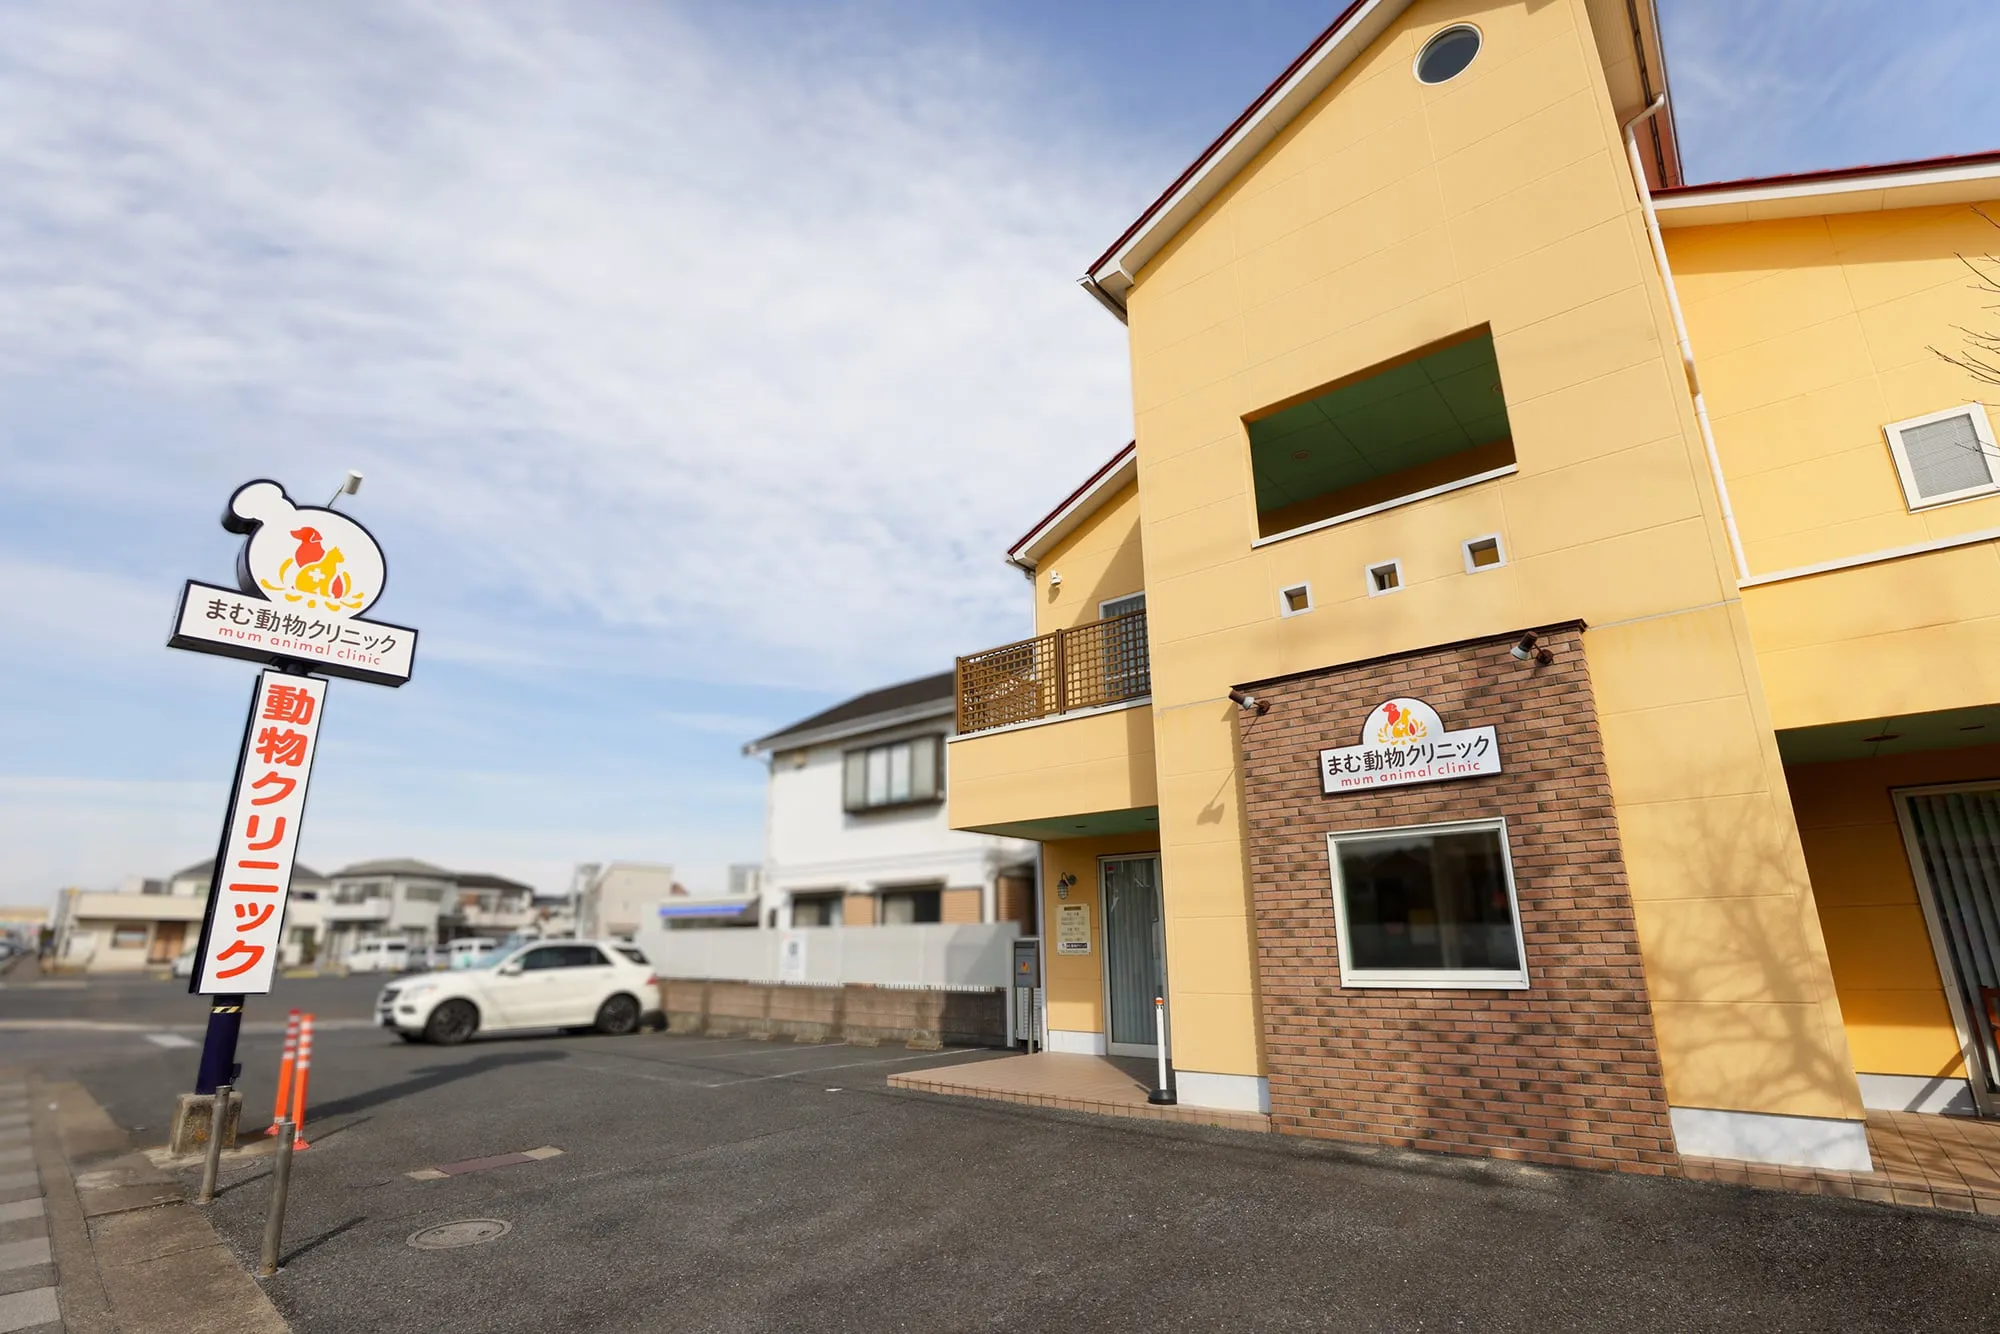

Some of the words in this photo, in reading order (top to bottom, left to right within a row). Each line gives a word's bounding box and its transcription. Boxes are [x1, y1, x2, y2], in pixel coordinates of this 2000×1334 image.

[206, 597, 397, 654] まむ動物クリニック
[218, 625, 262, 643] mum
[270, 636, 331, 656] animal
[337, 647, 381, 666] clinic
[1327, 735, 1490, 776] まむ動物クリニック
[1341, 775, 1374, 787] mum
[1380, 764, 1432, 782] animal
[1437, 760, 1481, 775] clinic
[215, 683, 317, 981] 動物クリニック
